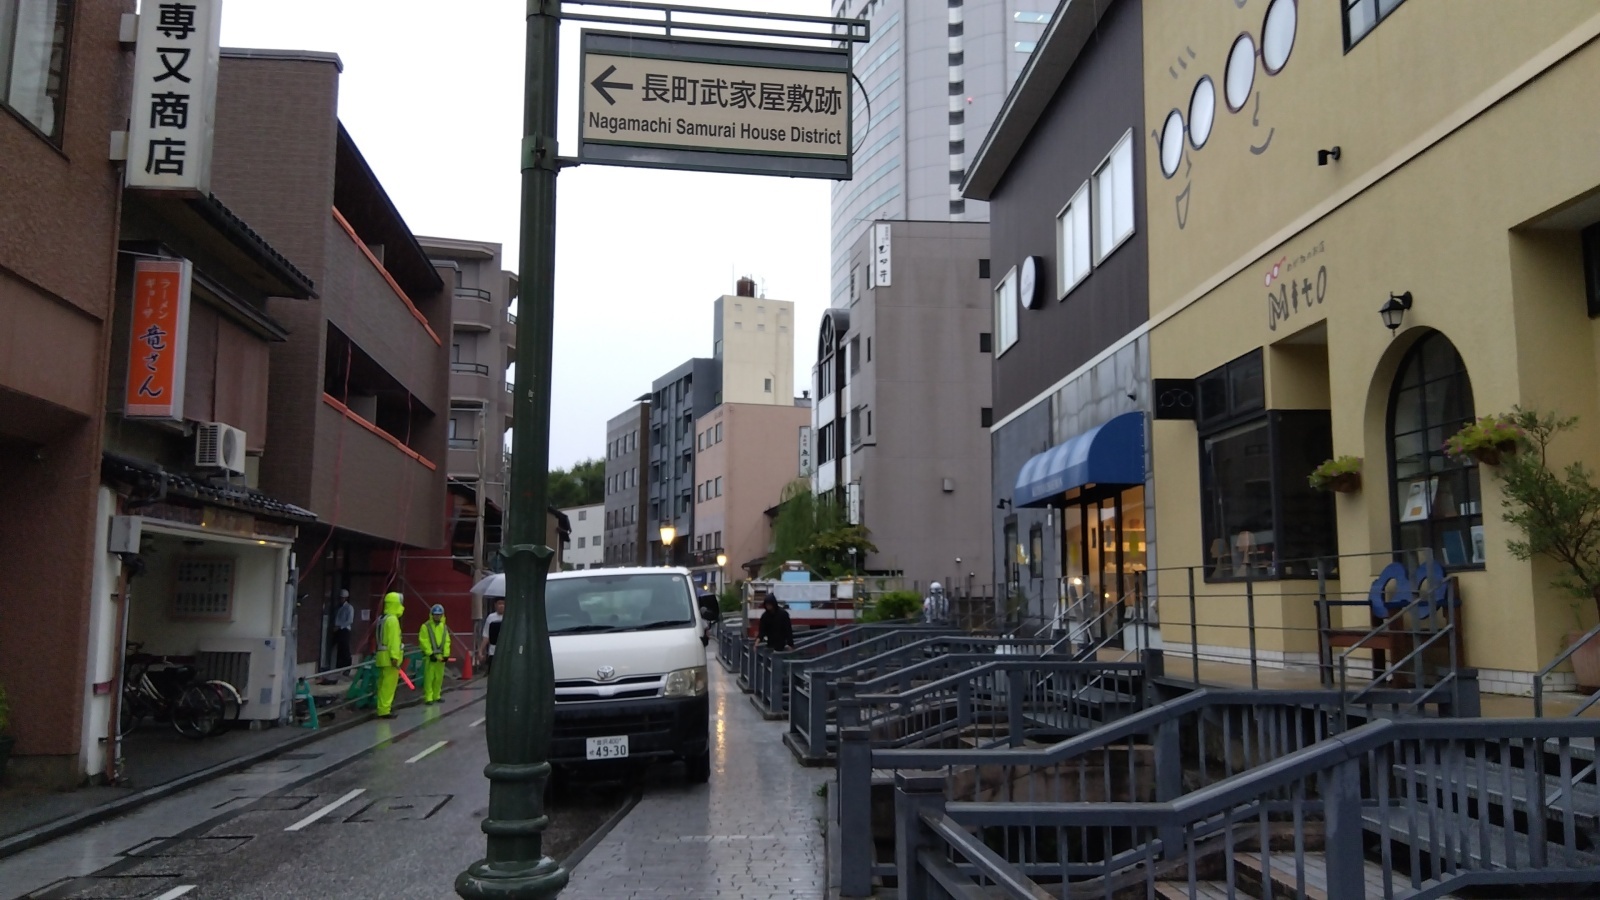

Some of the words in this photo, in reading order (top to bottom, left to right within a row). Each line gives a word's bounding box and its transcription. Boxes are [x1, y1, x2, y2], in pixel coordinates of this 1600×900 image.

[144, 2, 196, 176] 専又商店
[641, 73, 842, 115] 長町武家屋敷跡
[589, 111, 671, 134] Nagamachi
[676, 118, 736, 138] Samurai
[740, 123, 786, 142] House
[791, 126, 842, 145] District
[158, 278, 171, 320] ラーメン
[138, 324, 167, 398] 竜さん
[596, 744, 627, 757] 49-30
